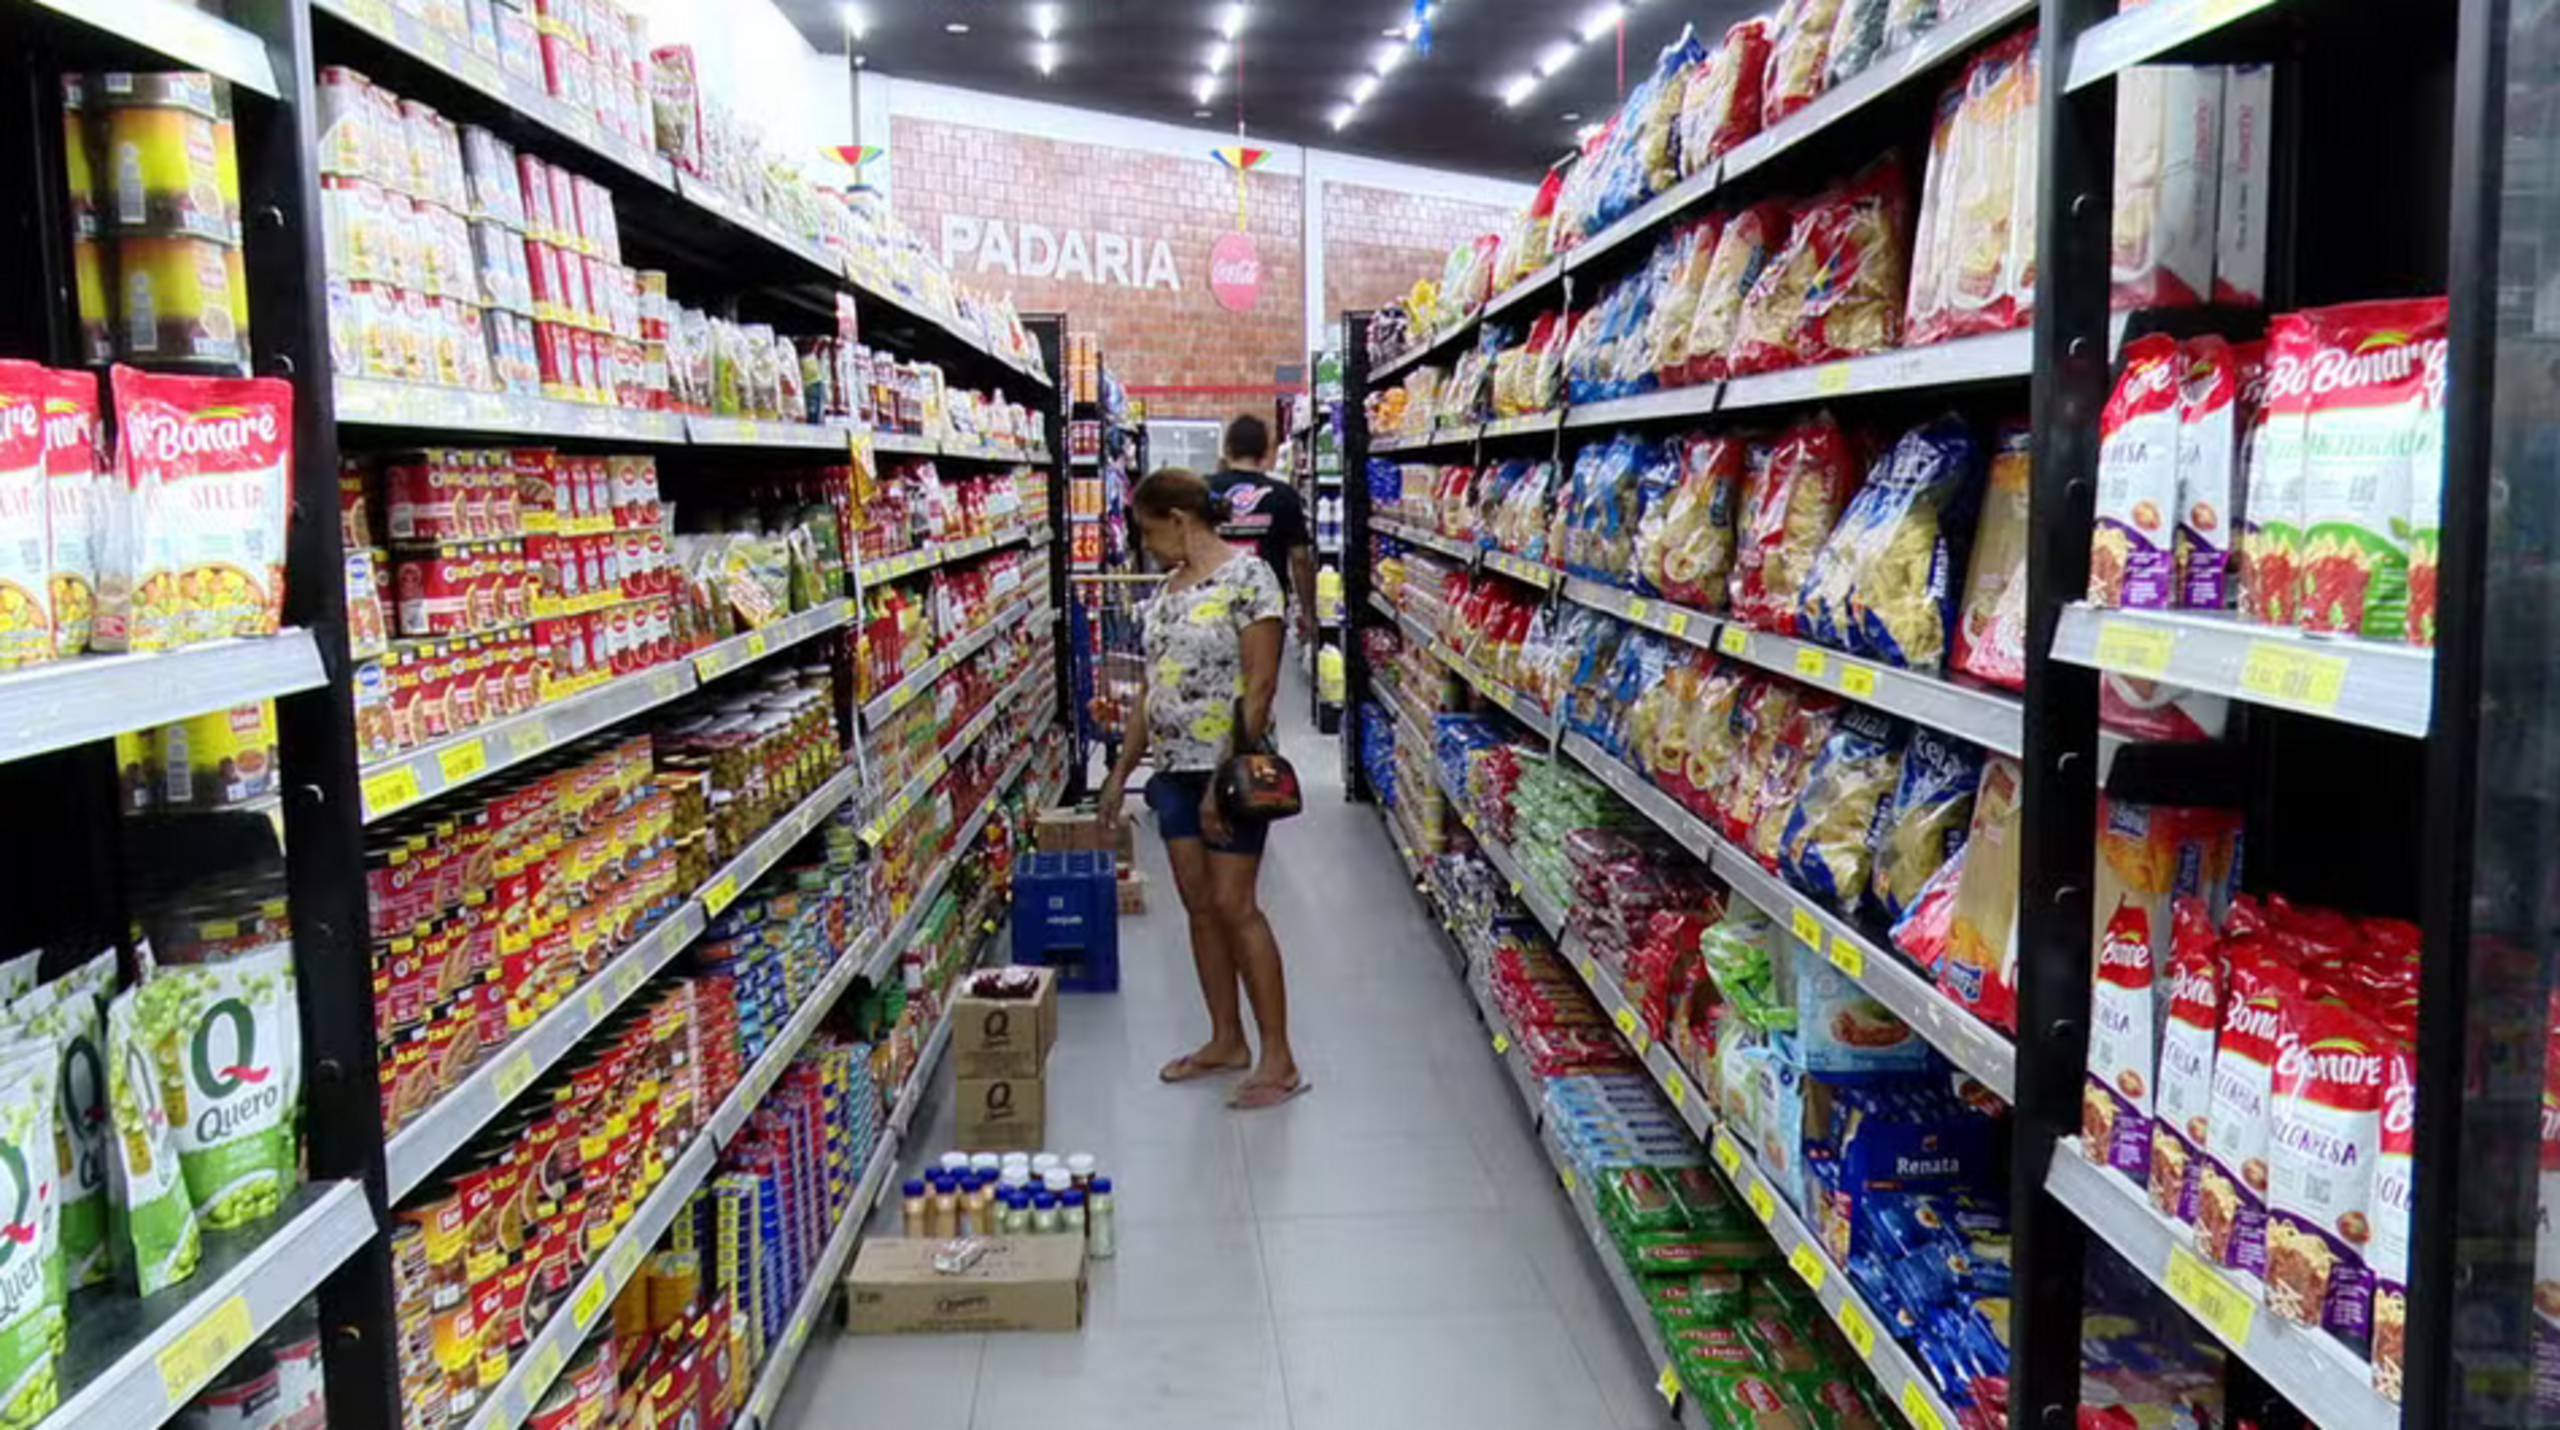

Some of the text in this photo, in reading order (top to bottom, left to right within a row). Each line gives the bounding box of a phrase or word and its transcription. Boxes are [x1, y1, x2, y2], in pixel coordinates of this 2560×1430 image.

[941, 213, 1181, 291] PADARIA
[156, 411, 278, 461] Bonare
[2276, 1032, 2384, 1086] Bonare
[195, 1086, 278, 1143] Quero
[1896, 1156, 1960, 1175] Renata
